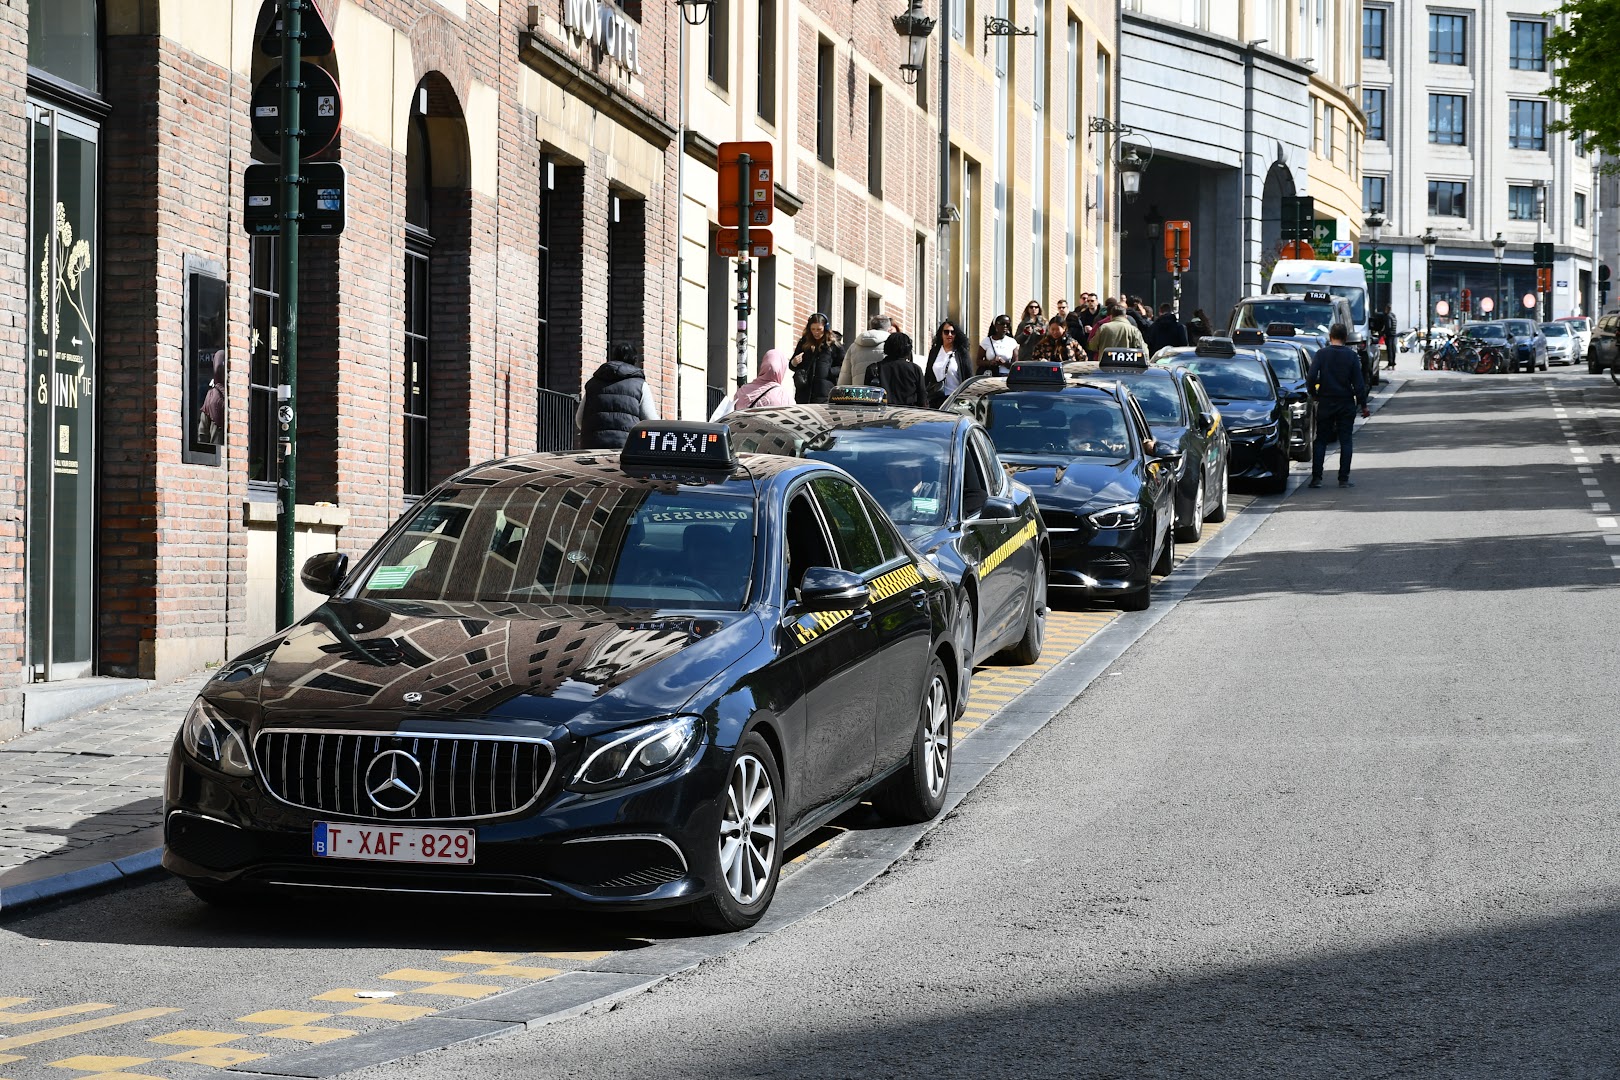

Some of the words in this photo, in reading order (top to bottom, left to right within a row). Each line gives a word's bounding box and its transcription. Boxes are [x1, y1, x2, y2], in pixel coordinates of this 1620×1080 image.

[566, 0, 641, 75] NOVOTEL
[1111, 351, 1138, 362] TAXI
[648, 431, 707, 453] TAXI
[317, 842, 325, 853] B
